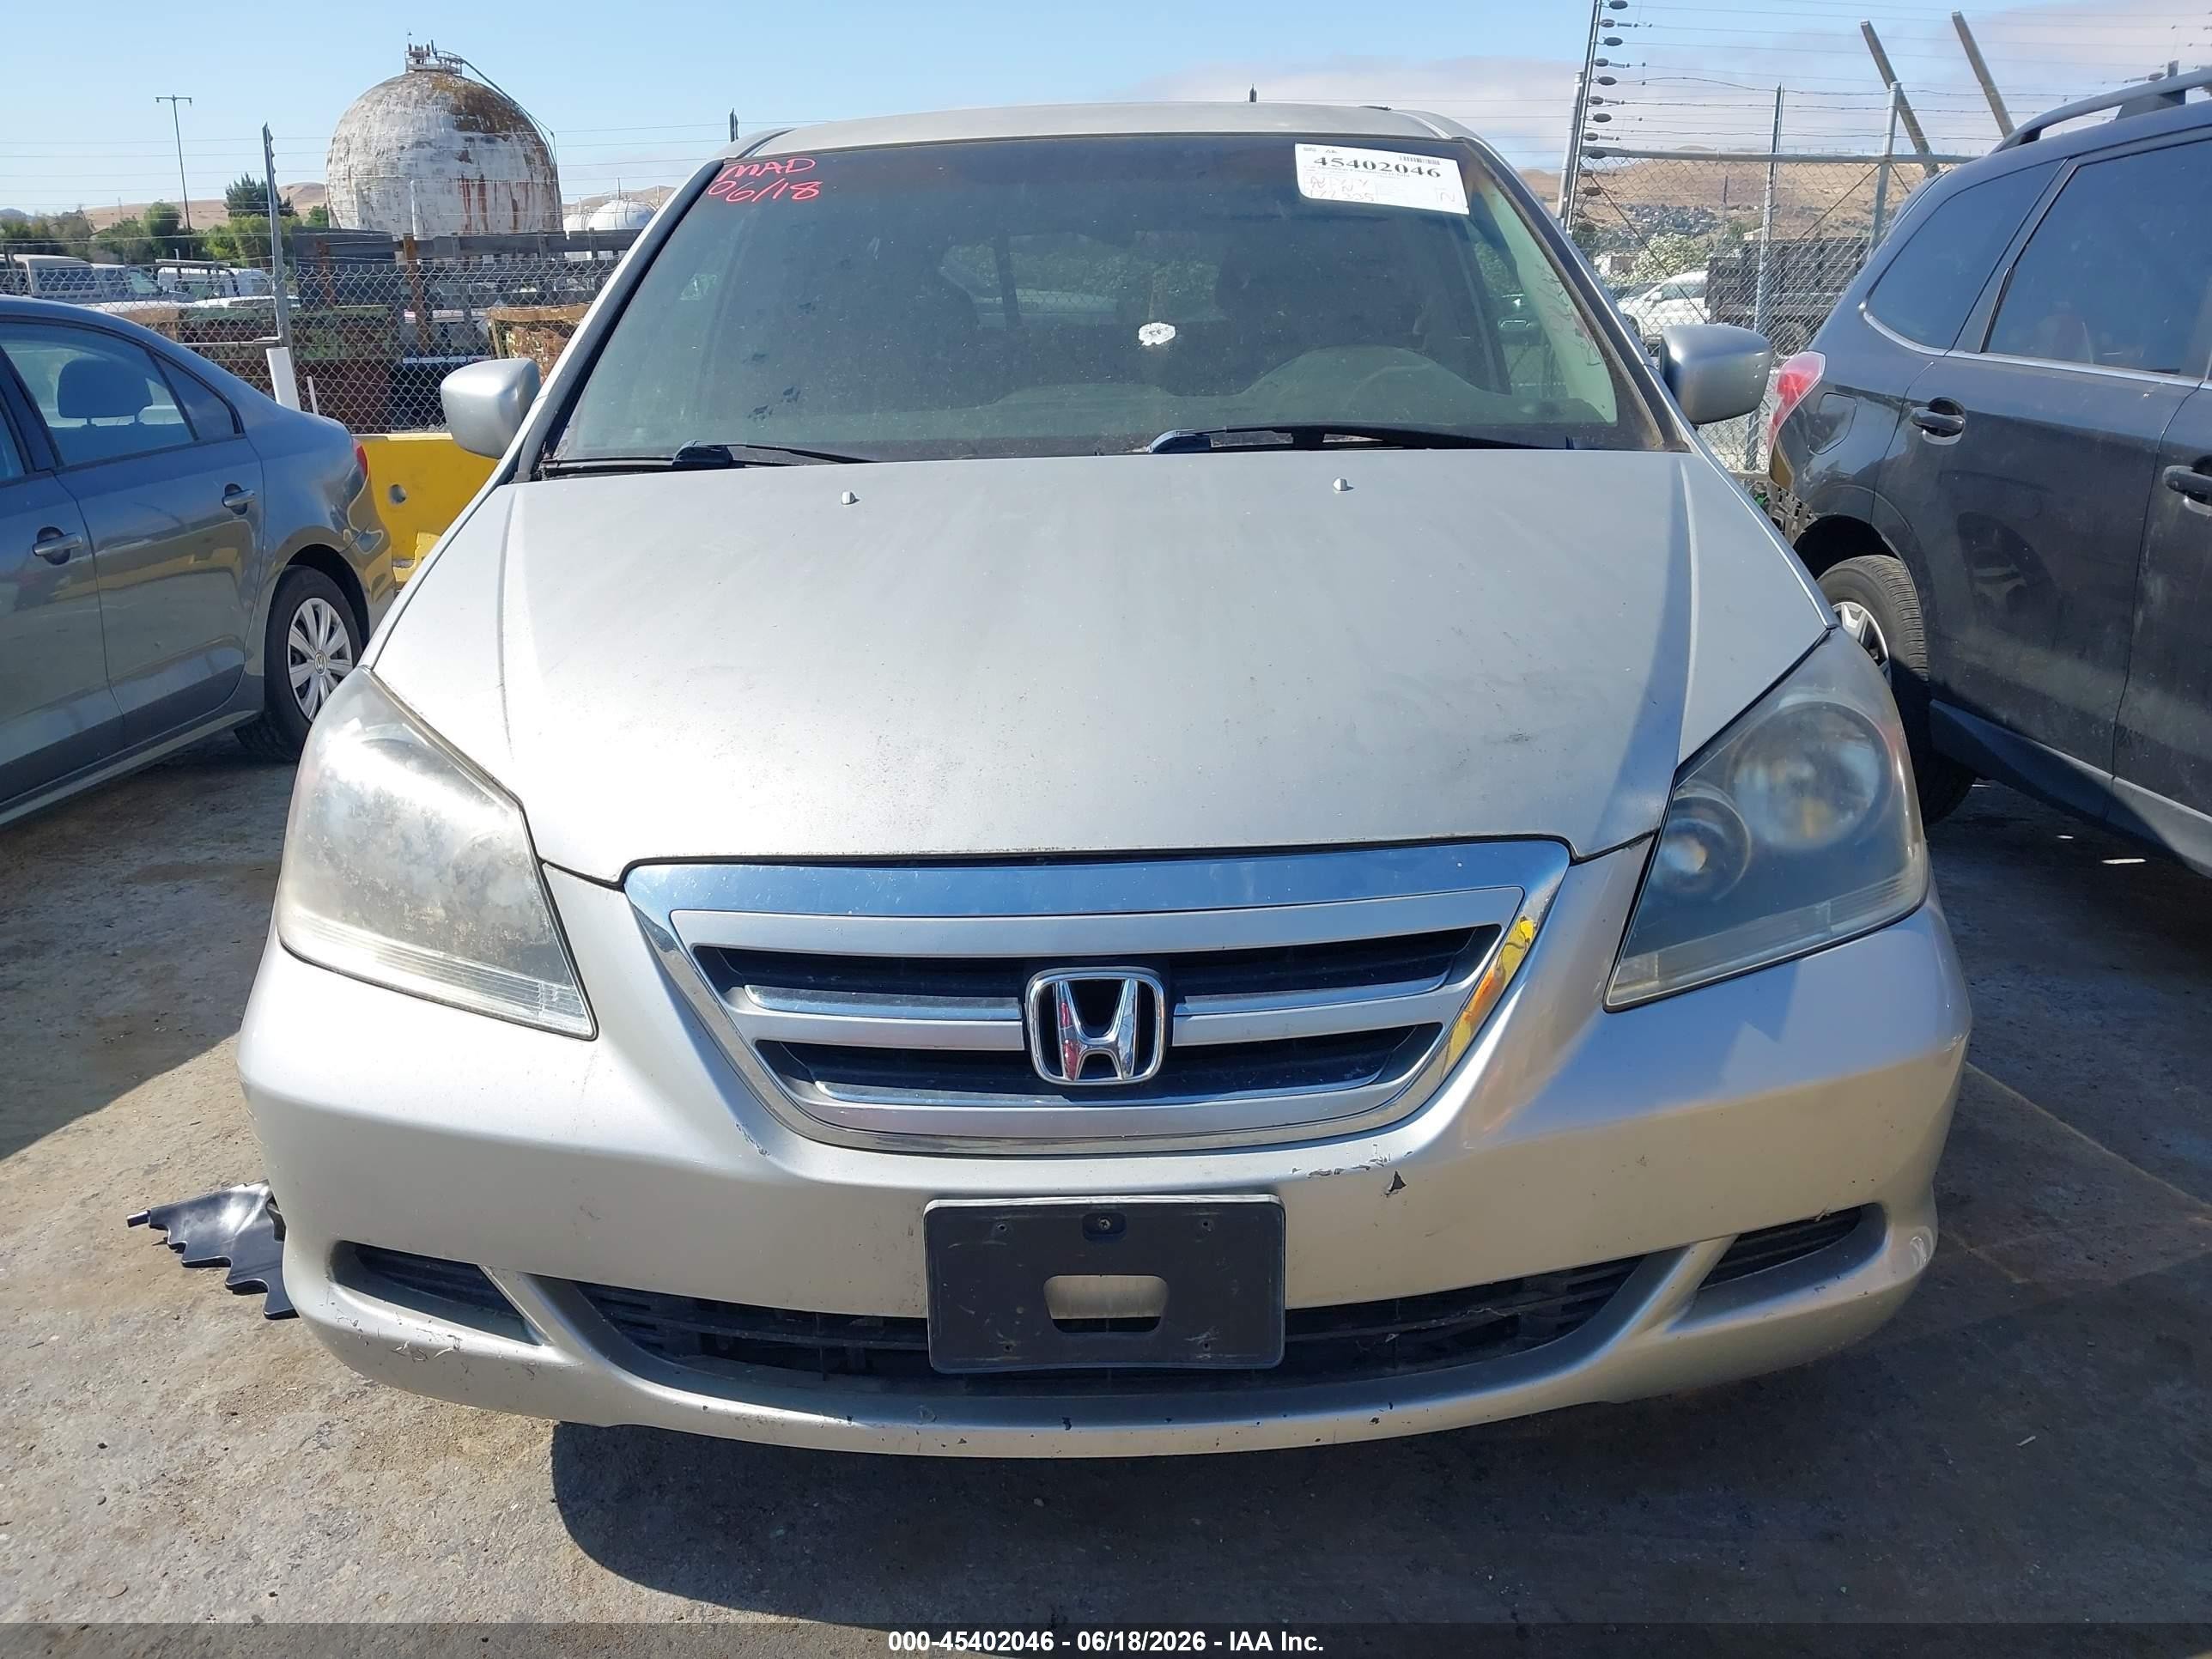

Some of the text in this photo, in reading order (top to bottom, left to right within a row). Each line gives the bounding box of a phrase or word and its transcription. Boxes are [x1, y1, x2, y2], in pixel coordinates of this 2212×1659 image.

[715, 158, 816, 182] MAD
[1314, 156, 1441, 178] 45402046
[708, 178, 823, 203] 06/18
